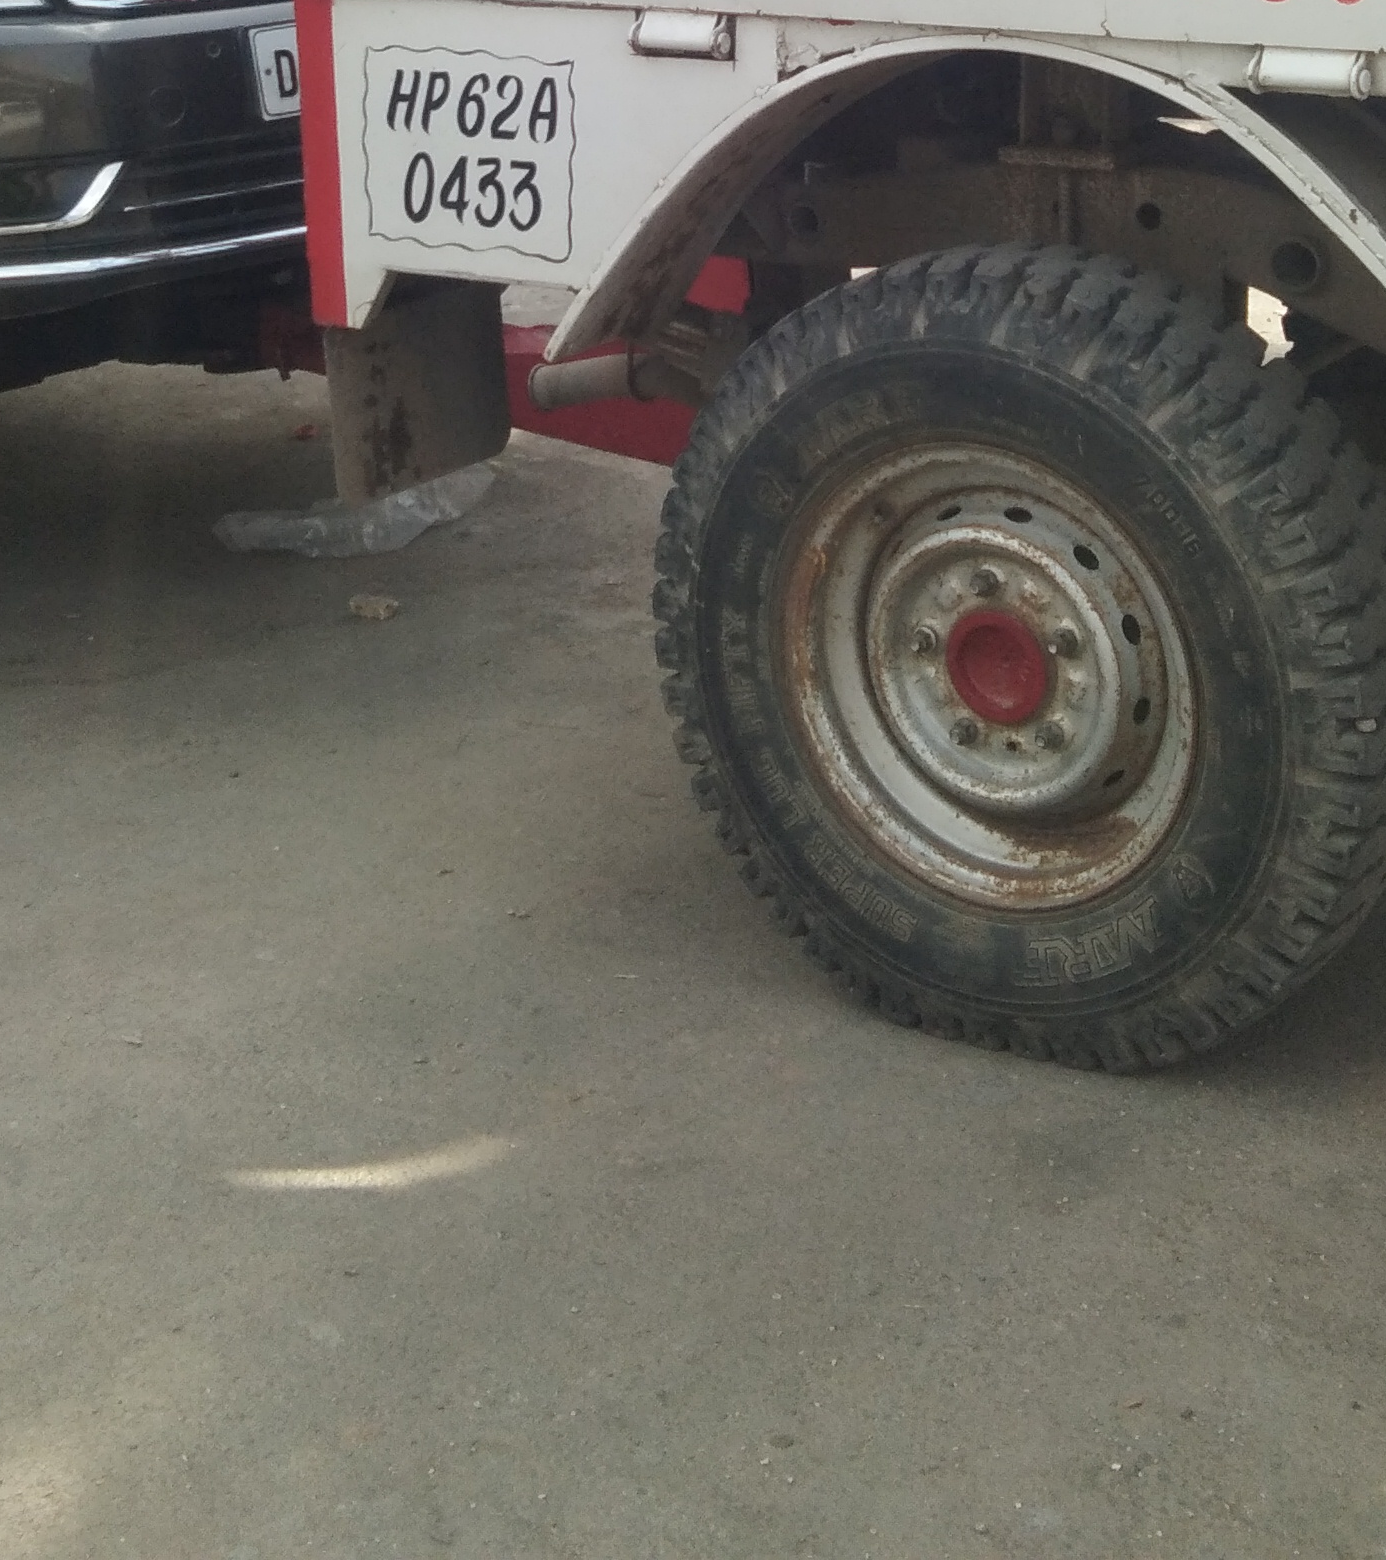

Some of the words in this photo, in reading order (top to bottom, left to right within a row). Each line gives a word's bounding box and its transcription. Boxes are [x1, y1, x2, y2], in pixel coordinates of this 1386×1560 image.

[403, 151, 543, 232] 0433
[804, 831, 918, 942] SUPER
[1013, 894, 1162, 987] MRF
